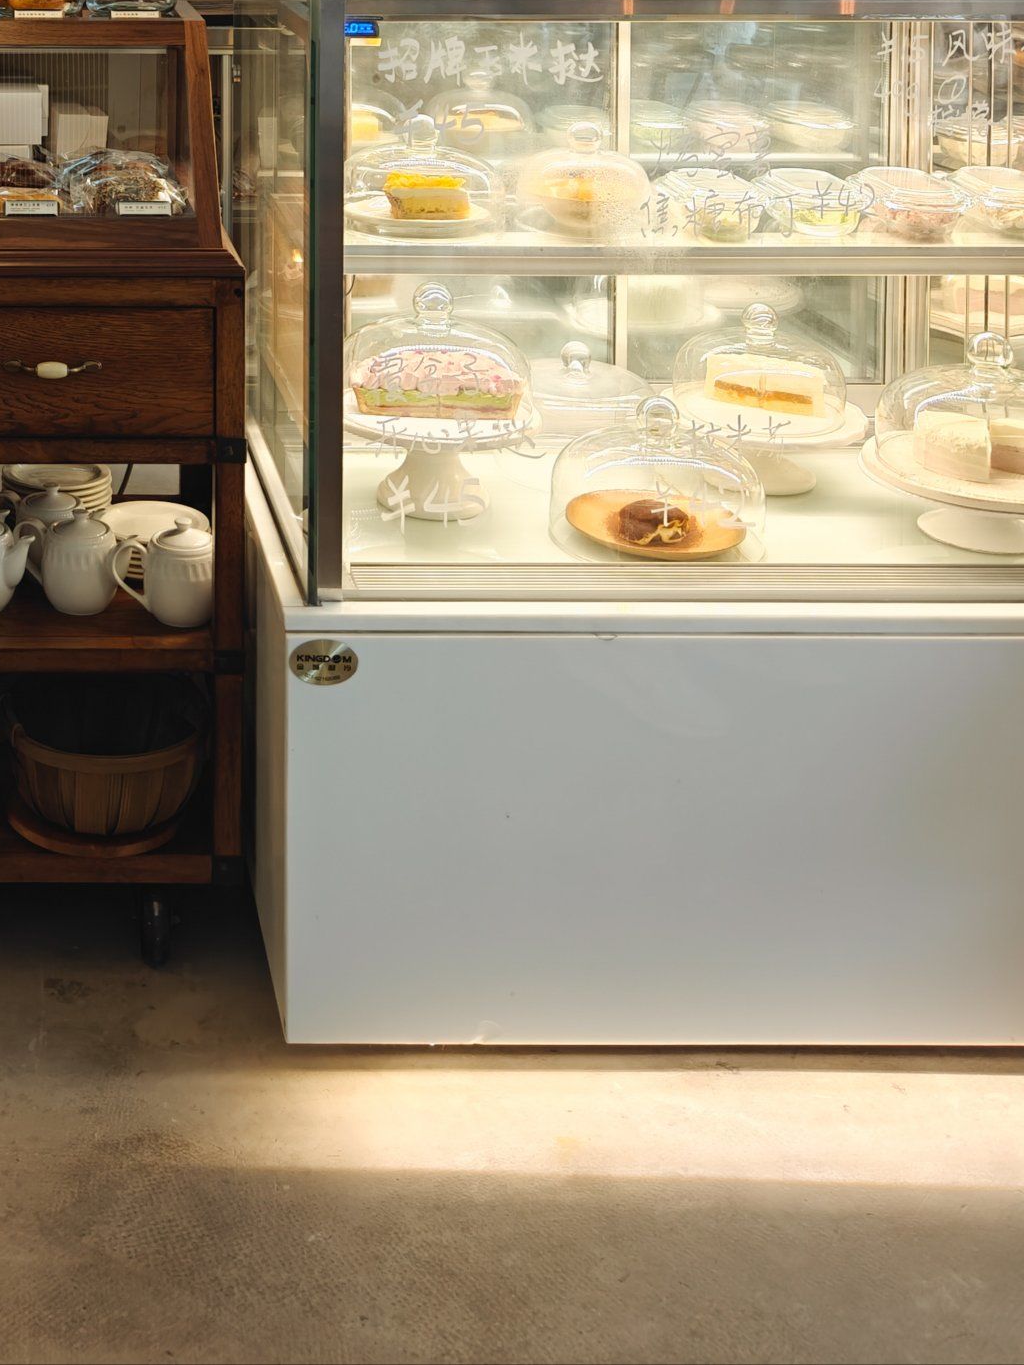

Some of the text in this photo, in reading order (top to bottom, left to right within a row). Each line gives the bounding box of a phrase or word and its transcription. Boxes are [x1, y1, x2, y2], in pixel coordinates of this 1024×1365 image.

[377, 31, 604, 86] 招牌玉米挞
[942, 22, 1024, 66] 风味
[380, 475, 488, 534] ¥45
